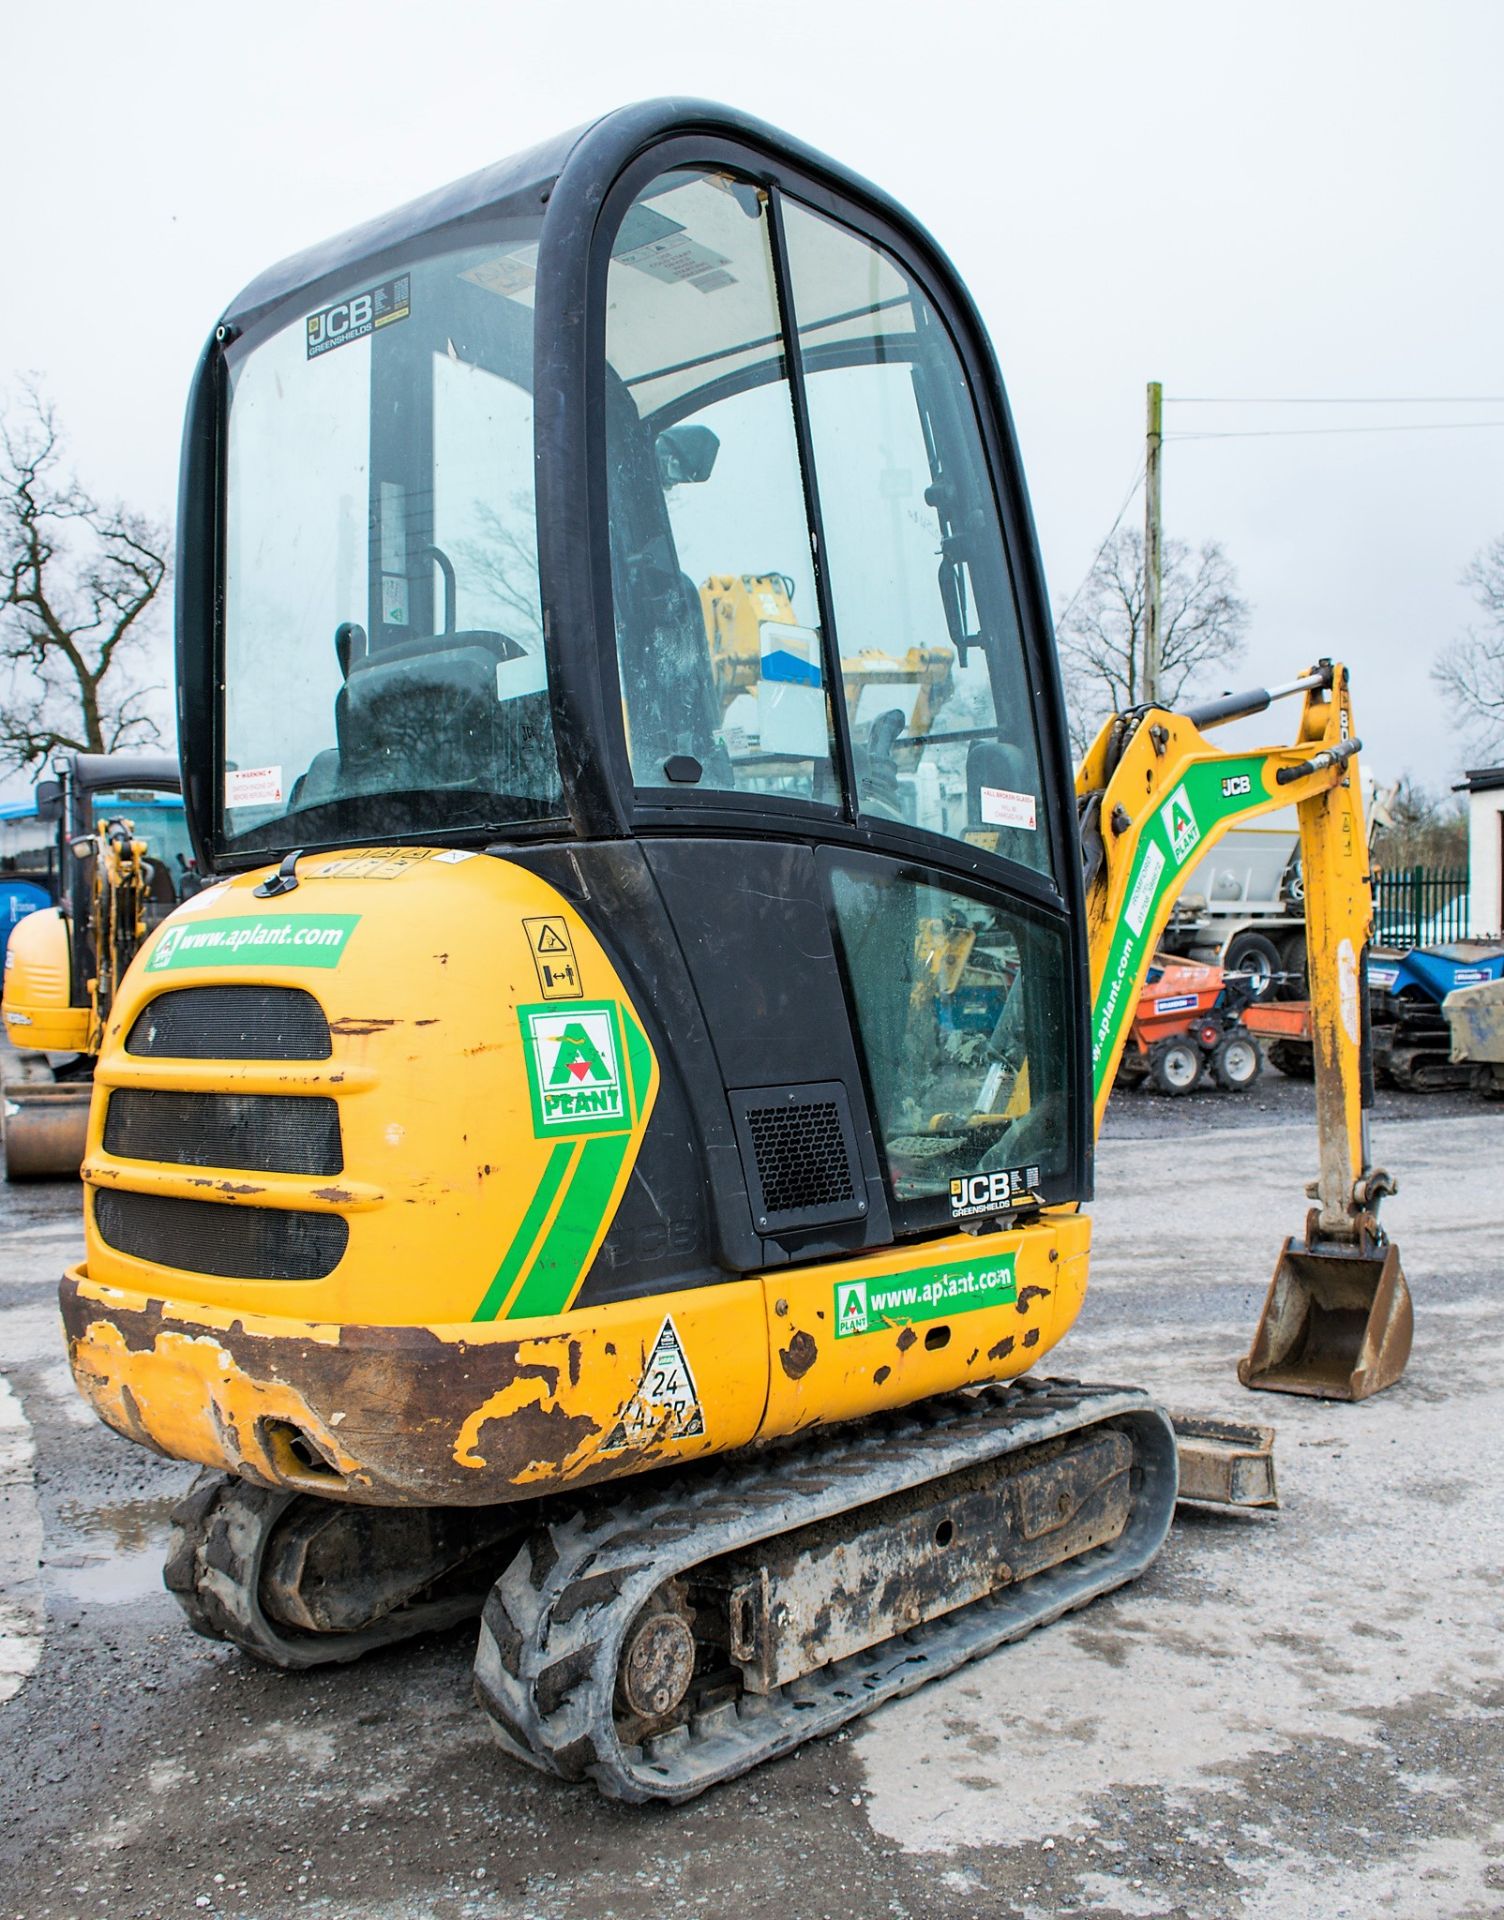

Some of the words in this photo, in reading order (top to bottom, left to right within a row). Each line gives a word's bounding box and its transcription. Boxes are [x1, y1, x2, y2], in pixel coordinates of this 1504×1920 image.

[308, 294, 373, 346] JCB
[308, 322, 373, 356] GREENSHIELDS
[1222, 776, 1251, 797] JCB
[1171, 801, 1192, 842] A
[1174, 825, 1198, 857] PLANT
[180, 923, 344, 952] www.aplant.com
[1092, 938, 1134, 1071] w.aplant.com
[549, 1022, 613, 1085] A
[543, 1089, 619, 1117] PLANT
[952, 1172, 1010, 1209] JCB
[952, 1200, 1011, 1218] GREENSHIELDS
[843, 1289, 864, 1318] A
[870, 1266, 1012, 1311] www.aplant.com
[840, 1317, 866, 1332] PLANT
[651, 1369, 678, 1398] 24
